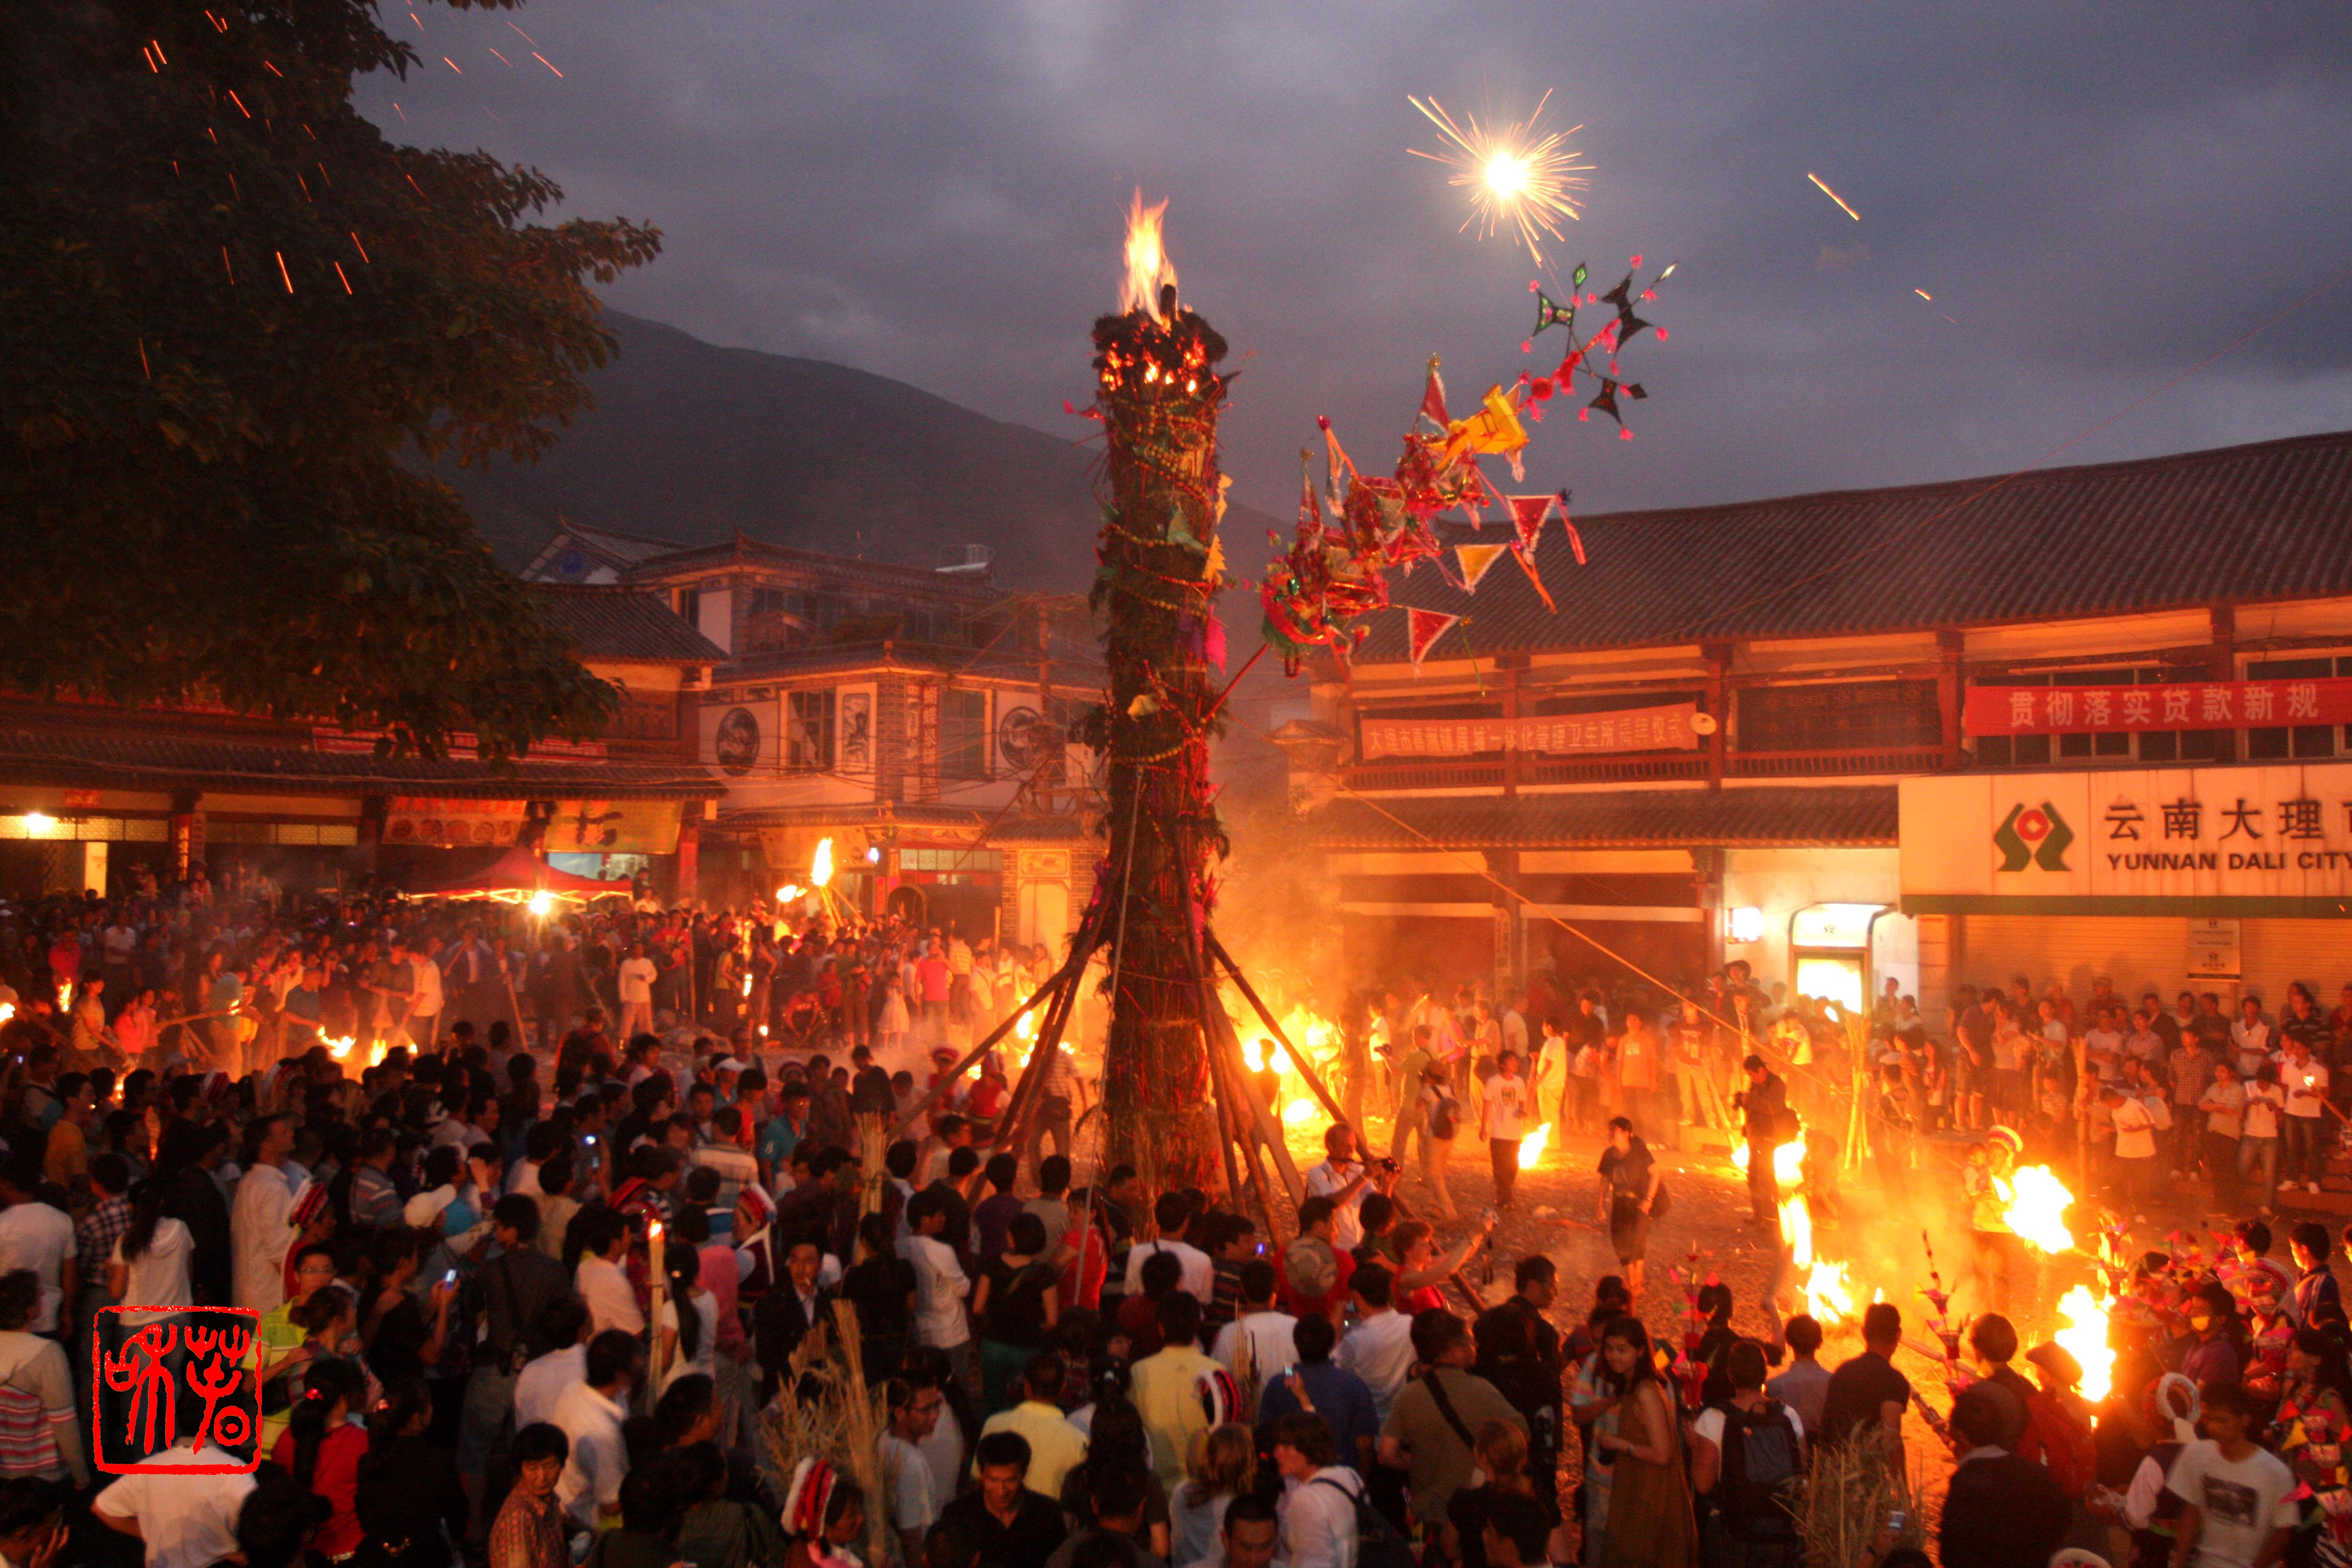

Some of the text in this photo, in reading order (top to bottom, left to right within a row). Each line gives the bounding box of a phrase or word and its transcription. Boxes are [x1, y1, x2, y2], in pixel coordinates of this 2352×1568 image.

[2008, 684, 2318, 728] 贯彻落实贷款新规
[2105, 798, 2352, 841] 云南大理
[2106, 852, 2217, 871] YUNNAN
[2228, 852, 2285, 870] DALI
